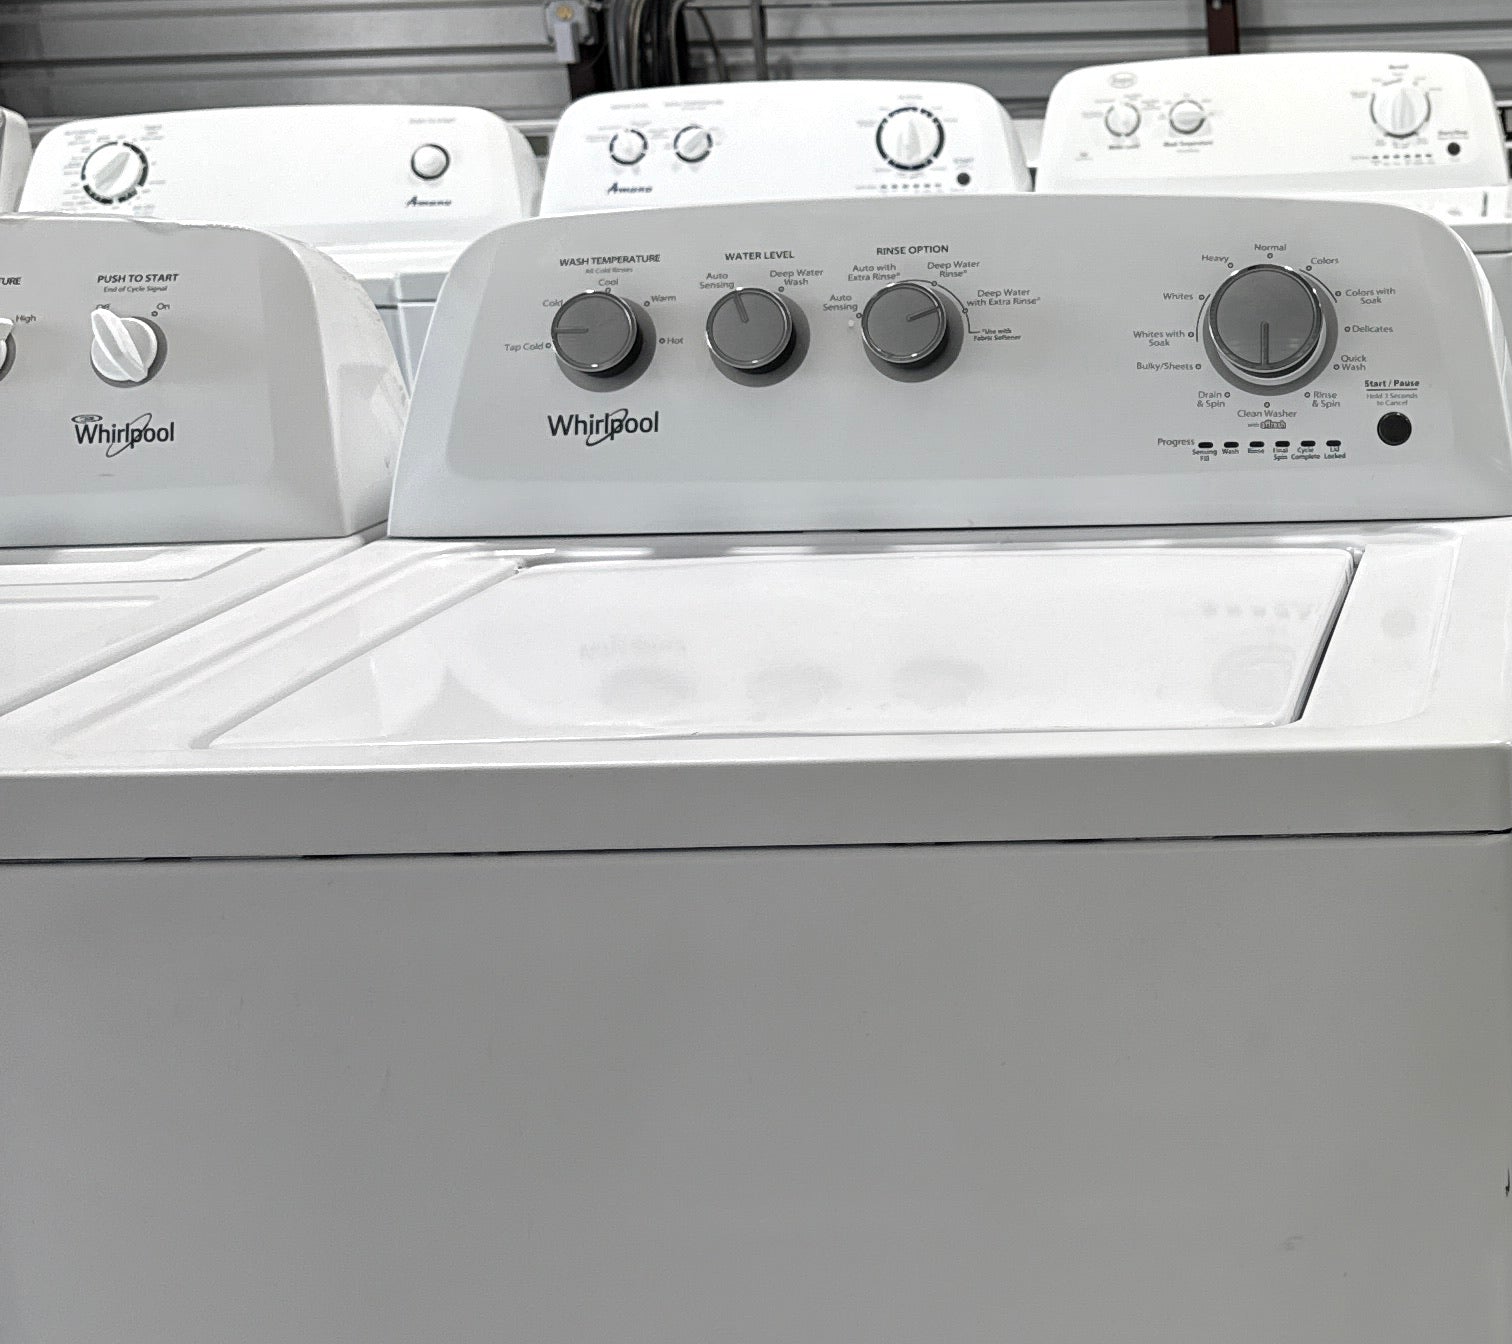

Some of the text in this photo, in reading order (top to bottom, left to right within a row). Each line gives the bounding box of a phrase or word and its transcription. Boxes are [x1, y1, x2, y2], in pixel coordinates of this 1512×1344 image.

[876, 245, 949, 256] RINSE OPTION
[559, 254, 661, 266] WASH TEMPERATURE
[725, 251, 794, 261] WATER LEVEL
[1201, 254, 1229, 263] Heavy
[927, 260, 980, 270] Deep Water
[1311, 257, 1339, 265] Colors
[852, 263, 896, 272] Auto with
[769, 269, 823, 278] Deep Water
[848, 273, 872, 281] Extra
[97, 273, 180, 284] PUSH TO START
[599, 278, 618, 286] Cool
[784, 278, 808, 286] Wash
[127, 285, 146, 293] Cycle
[700, 281, 735, 289] Sensing
[977, 288, 1030, 298] Deep Water
[1345, 287, 1396, 297] Colors with
[651, 294, 676, 302] Warm
[830, 294, 852, 302] Auto
[988, 298, 1011, 306] Extra
[1360, 297, 1382, 305] Soak
[156, 302, 170, 310] On
[542, 299, 563, 307] Cold
[823, 303, 858, 312] Sensing
[16, 314, 36, 323] High
[1352, 325, 1393, 333] Delicates
[1133, 330, 1185, 339] Whites with
[667, 337, 684, 345] Hot
[1148, 338, 1170, 347] Soak
[504, 342, 543, 352] Tap Cold
[1341, 354, 1367, 363] Quick
[1136, 362, 1193, 371] Bulky/Sheets
[1364, 380, 1386, 388] Start
[1393, 379, 1420, 387] Pause
[1198, 391, 1222, 399] Drain
[1313, 391, 1337, 399] Rinse
[1197, 400, 1225, 409] & Spin
[1312, 400, 1341, 409] & Spin
[1237, 409, 1297, 418] Clean Washer
[547, 411, 659, 441] Whirlpool
[74, 421, 175, 449] Whirlpool
[1157, 437, 1195, 447] Progress
